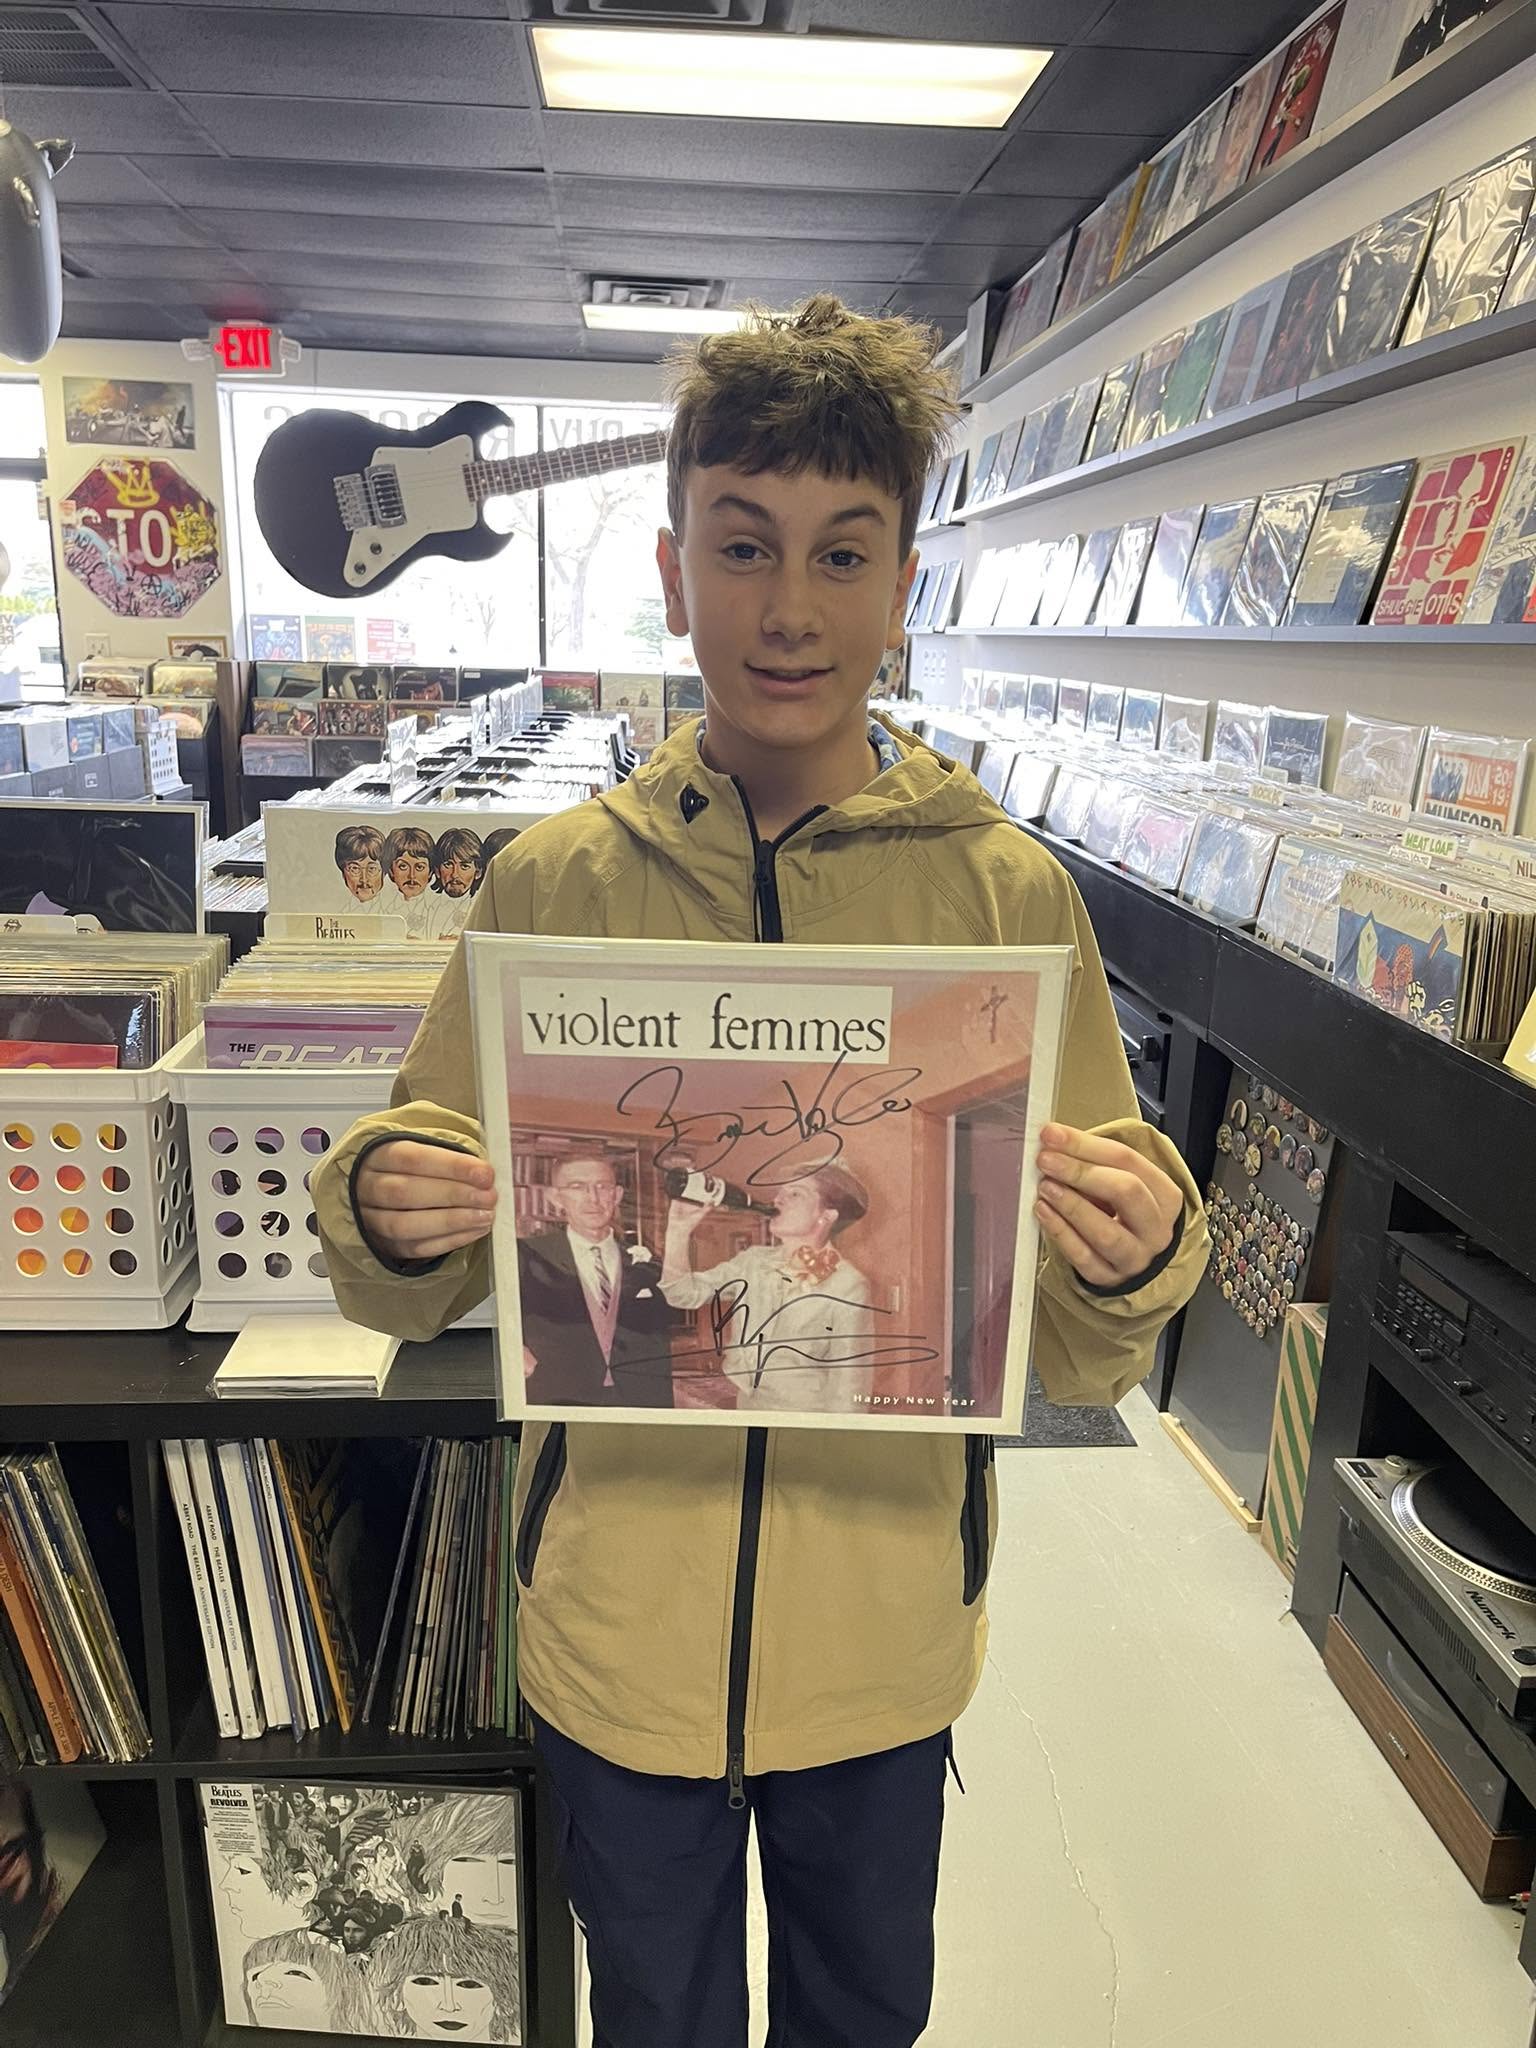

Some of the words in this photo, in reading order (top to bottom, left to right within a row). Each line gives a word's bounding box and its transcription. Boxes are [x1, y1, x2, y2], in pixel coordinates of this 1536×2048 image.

[222, 327, 271, 368] EXIT
[1378, 600, 1424, 617] SHUGGIE
[1425, 593, 1464, 616] OTIS
[1466, 760, 1491, 799] USA
[1371, 800, 1391, 815] ROCK
[1391, 803, 1403, 818] M
[1405, 832, 1429, 851] MEAT
[1429, 838, 1454, 857] LOAF
[527, 992, 681, 1048] violent
[709, 992, 886, 1052] femmes
[229, 1043, 256, 1053] THE
[853, 1394, 900, 1406] Happy
[906, 1396, 936, 1406] New
[942, 1397, 976, 1407] Year
[182, 1503, 191, 1521] ABBEY
[205, 1504, 215, 1523] ABBEY
[186, 1522, 194, 1538] ROAD
[209, 1524, 218, 1540] ROAD
[190, 1544, 198, 1556] THE
[213, 1546, 221, 1558] THE
[192, 1556, 202, 1580] BEATLES
[215, 1558, 225, 1582] BEATLES
[1466, 1590, 1517, 1640] Numark
[211, 1785, 242, 1798] BEATLES
